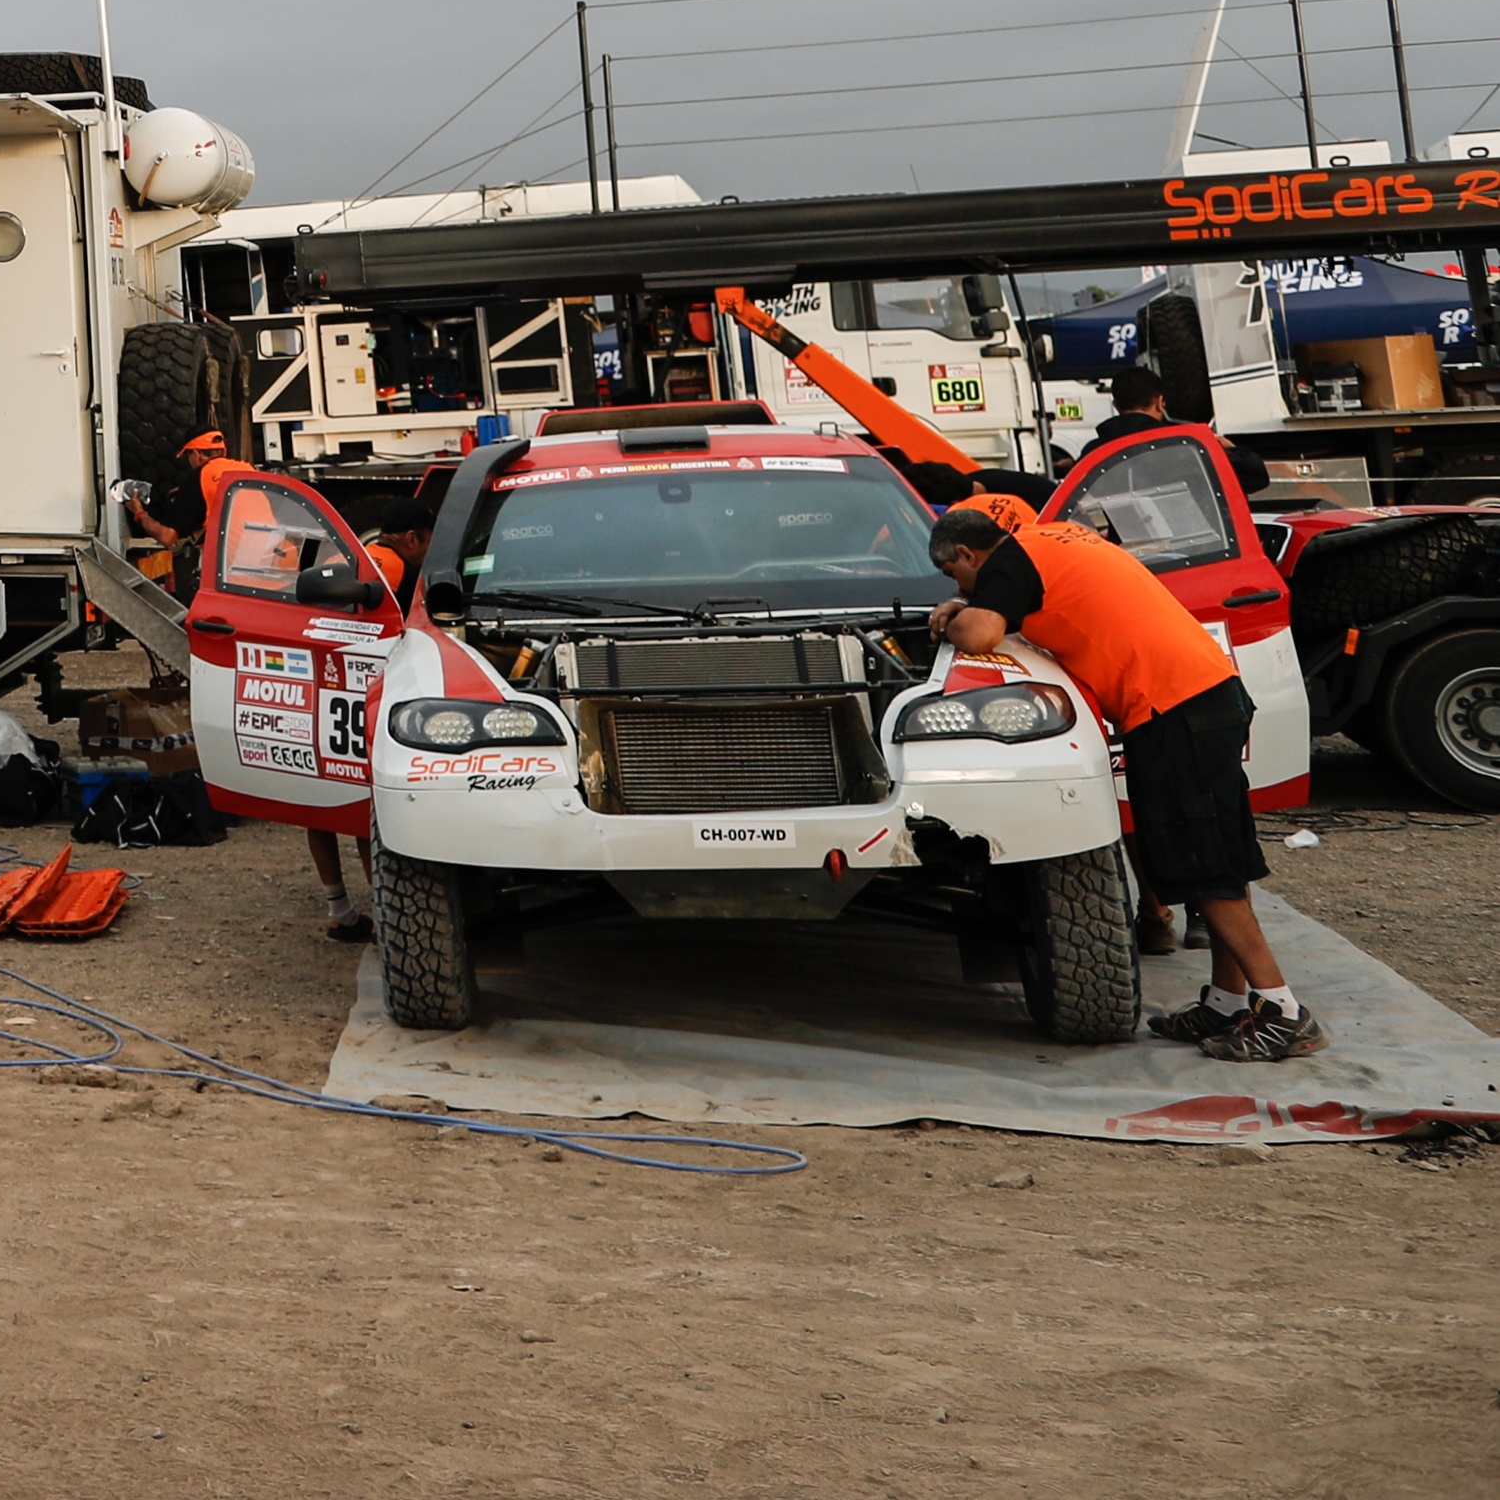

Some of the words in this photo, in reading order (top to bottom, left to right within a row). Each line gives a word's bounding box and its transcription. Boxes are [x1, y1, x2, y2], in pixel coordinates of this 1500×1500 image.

[1163, 172, 1434, 227] SodiCars
[937, 380, 980, 402] 680
[498, 471, 566, 488] MOTUL
[600, 465, 627, 475] PERU
[628, 463, 670, 473] BOLIVIA
[670, 460, 730, 470] ARGENTINA
[243, 679, 306, 706] MOTUL
[243, 750, 269, 762] sport
[407, 754, 556, 776] SodiCars
[325, 761, 366, 780] MOTUL
[467, 774, 536, 792] Racing
[701, 829, 787, 841] CH-007-WD
